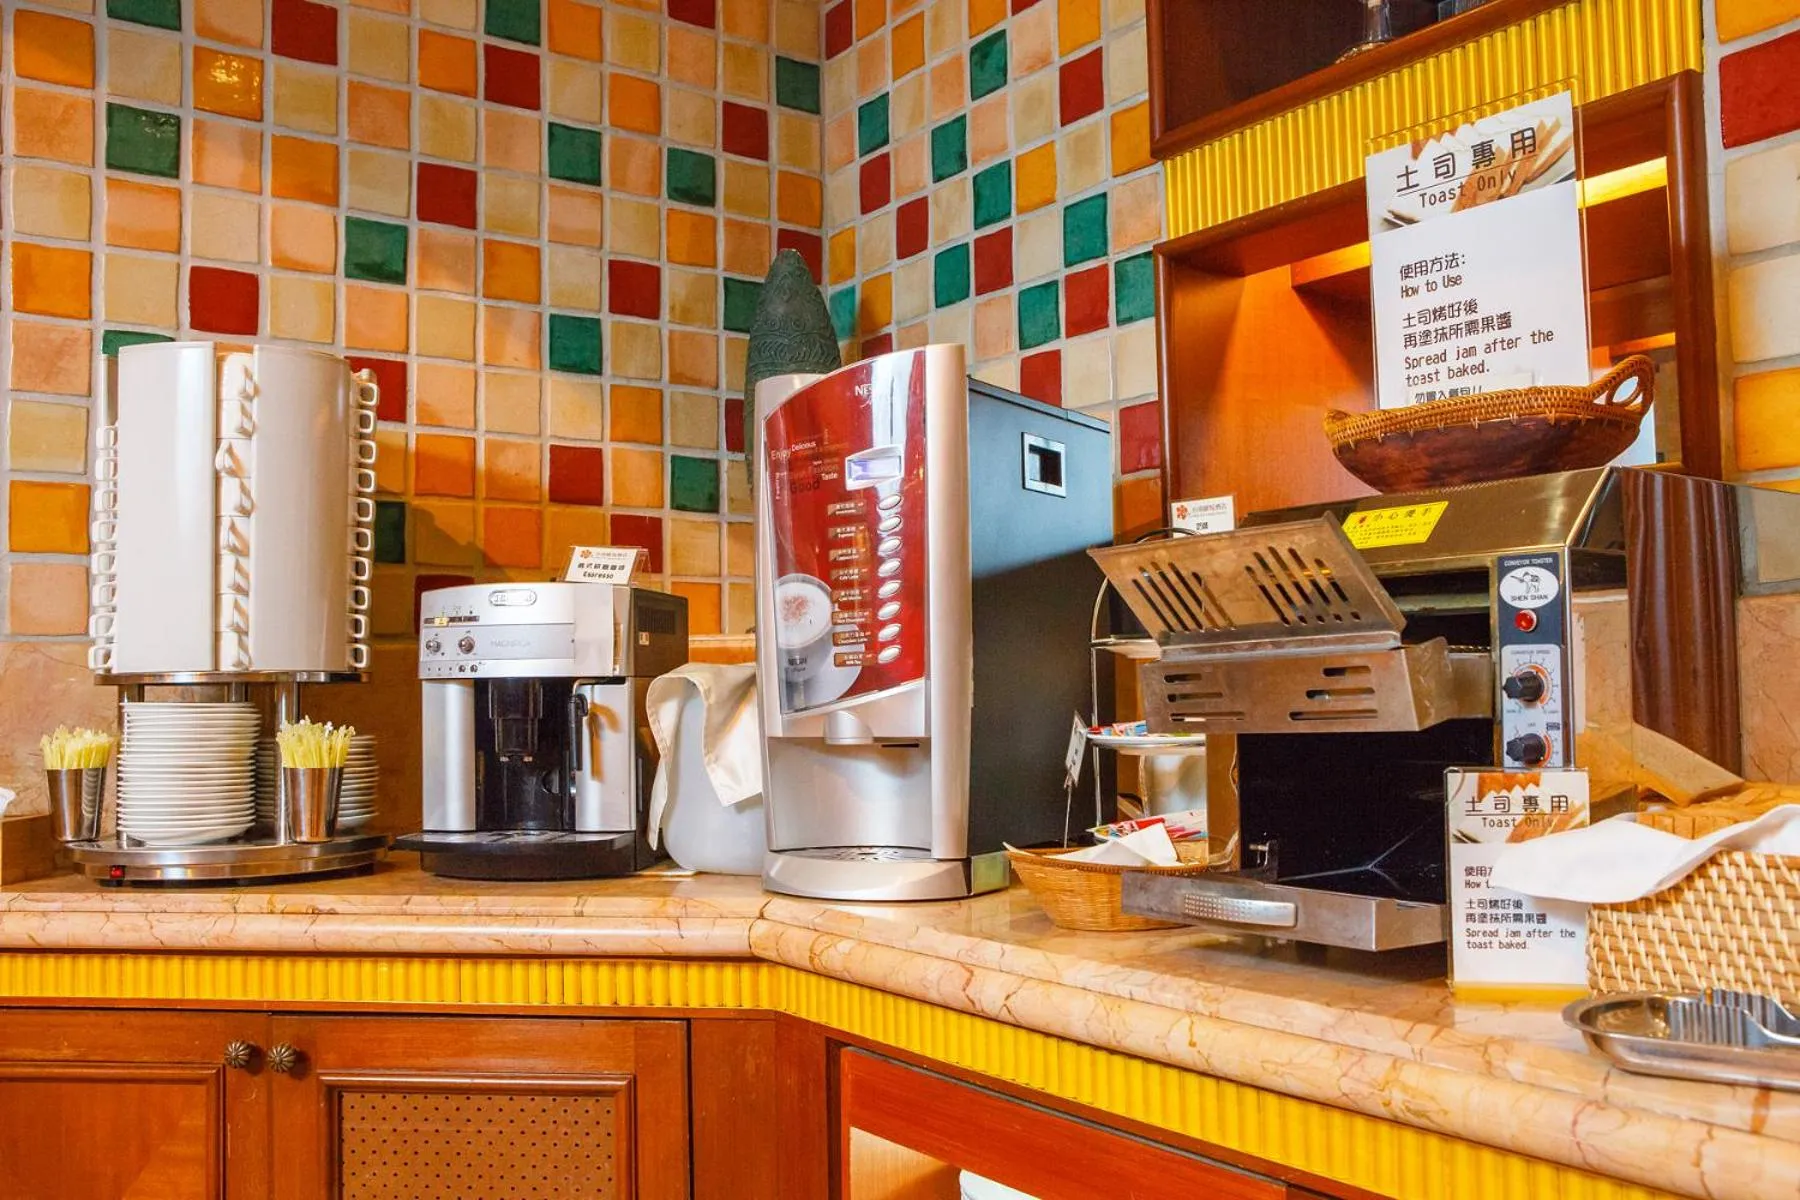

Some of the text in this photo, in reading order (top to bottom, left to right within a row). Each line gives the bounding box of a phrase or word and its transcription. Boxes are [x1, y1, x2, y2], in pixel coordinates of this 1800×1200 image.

[1396, 126, 1537, 193] 土司專用
[1419, 170, 1517, 208] Toast Only
[1400, 273, 1463, 299] How to Use
[1402, 298, 1478, 329] 土司烤好後
[1403, 311, 1512, 350] 再塗抹所需果醬
[1404, 328, 1554, 370] Spread jam after the
[1405, 360, 1490, 387] toast baked.
[583, 571, 614, 579] Espresso
[1465, 794, 1569, 813] 土司專用
[1482, 816, 1518, 828] Toast
[1464, 879, 1481, 889] How
[1465, 928, 1576, 939] Spread jam after the
[1466, 940, 1493, 949] toast
